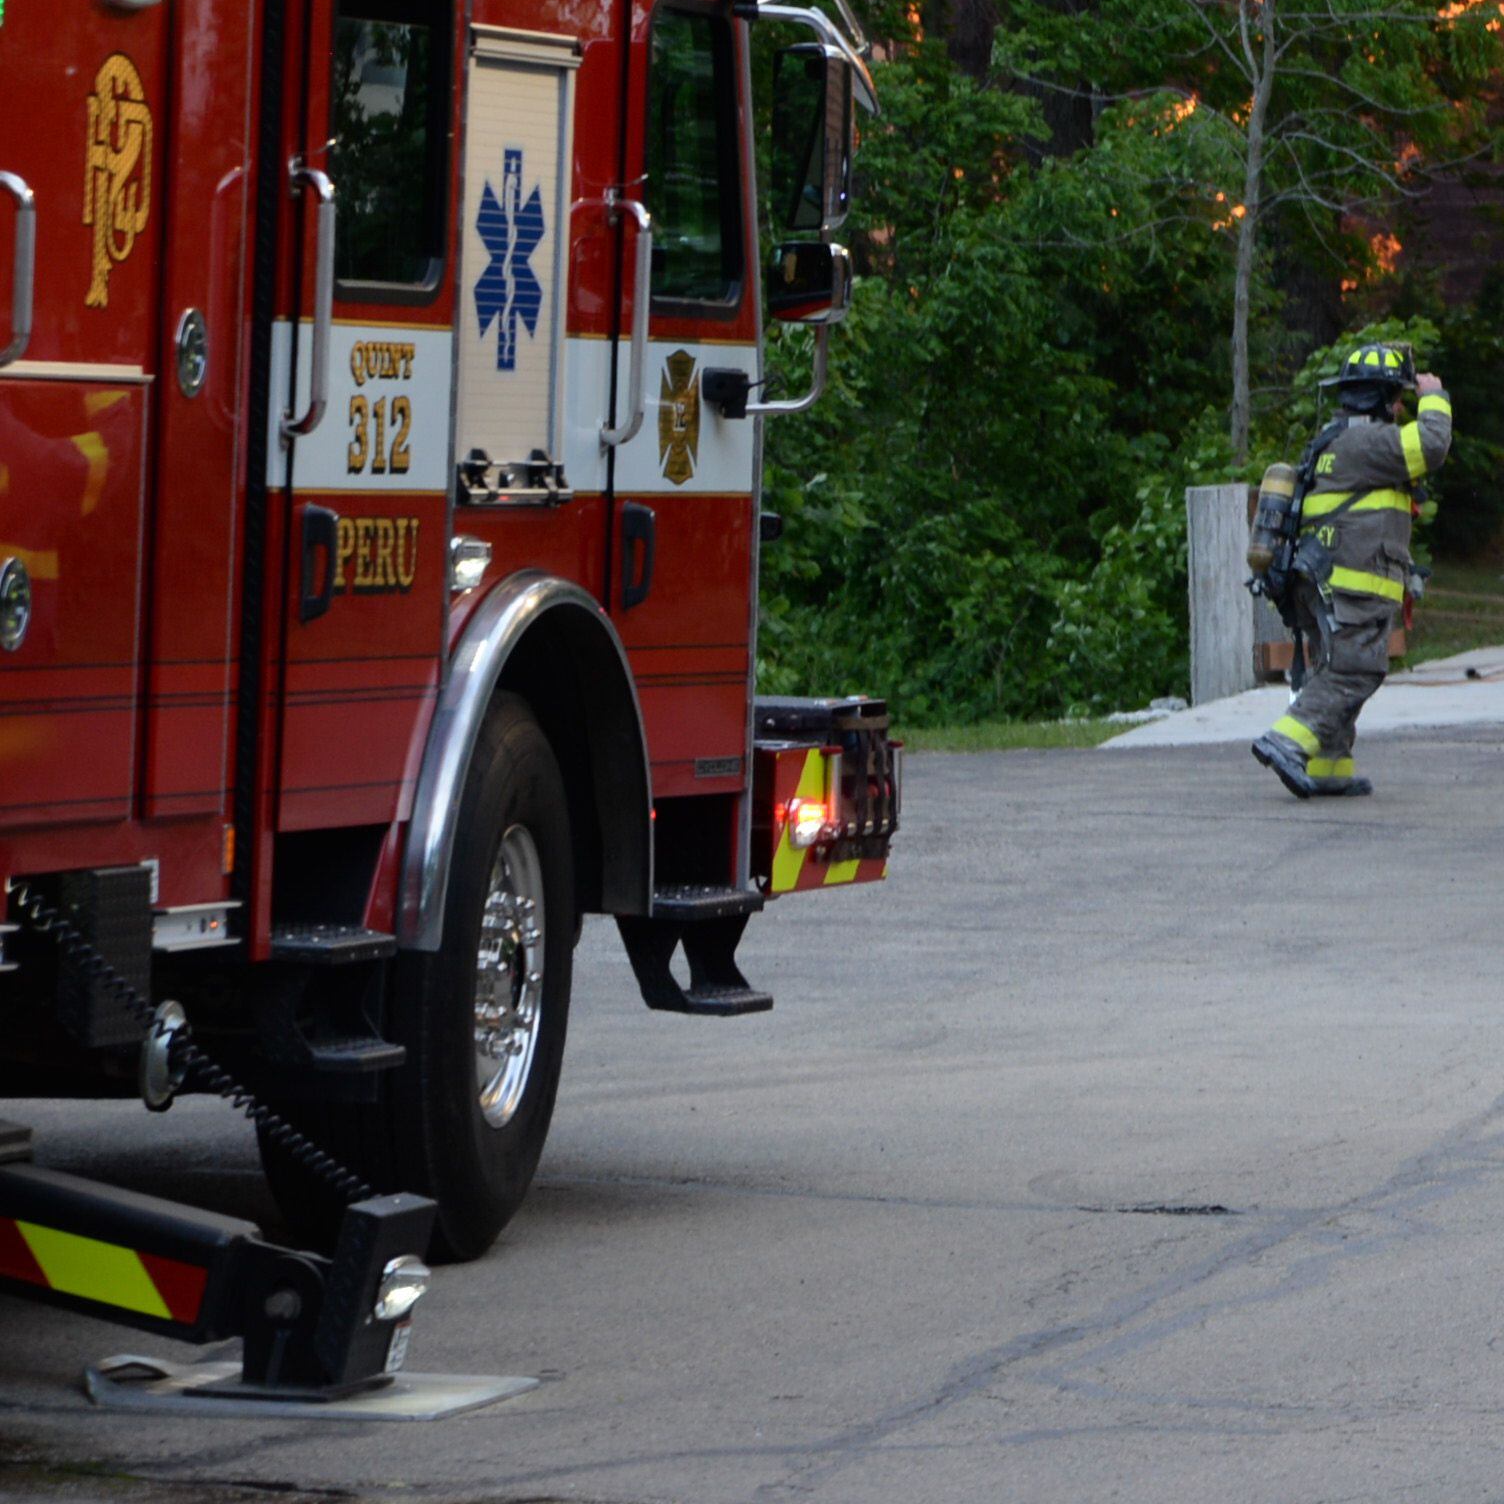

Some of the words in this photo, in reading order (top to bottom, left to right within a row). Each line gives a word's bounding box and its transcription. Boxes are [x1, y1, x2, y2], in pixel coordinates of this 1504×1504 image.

[350, 340, 416, 386] QUINT
[347, 394, 412, 475] 312
[333, 516, 420, 592] PERU
